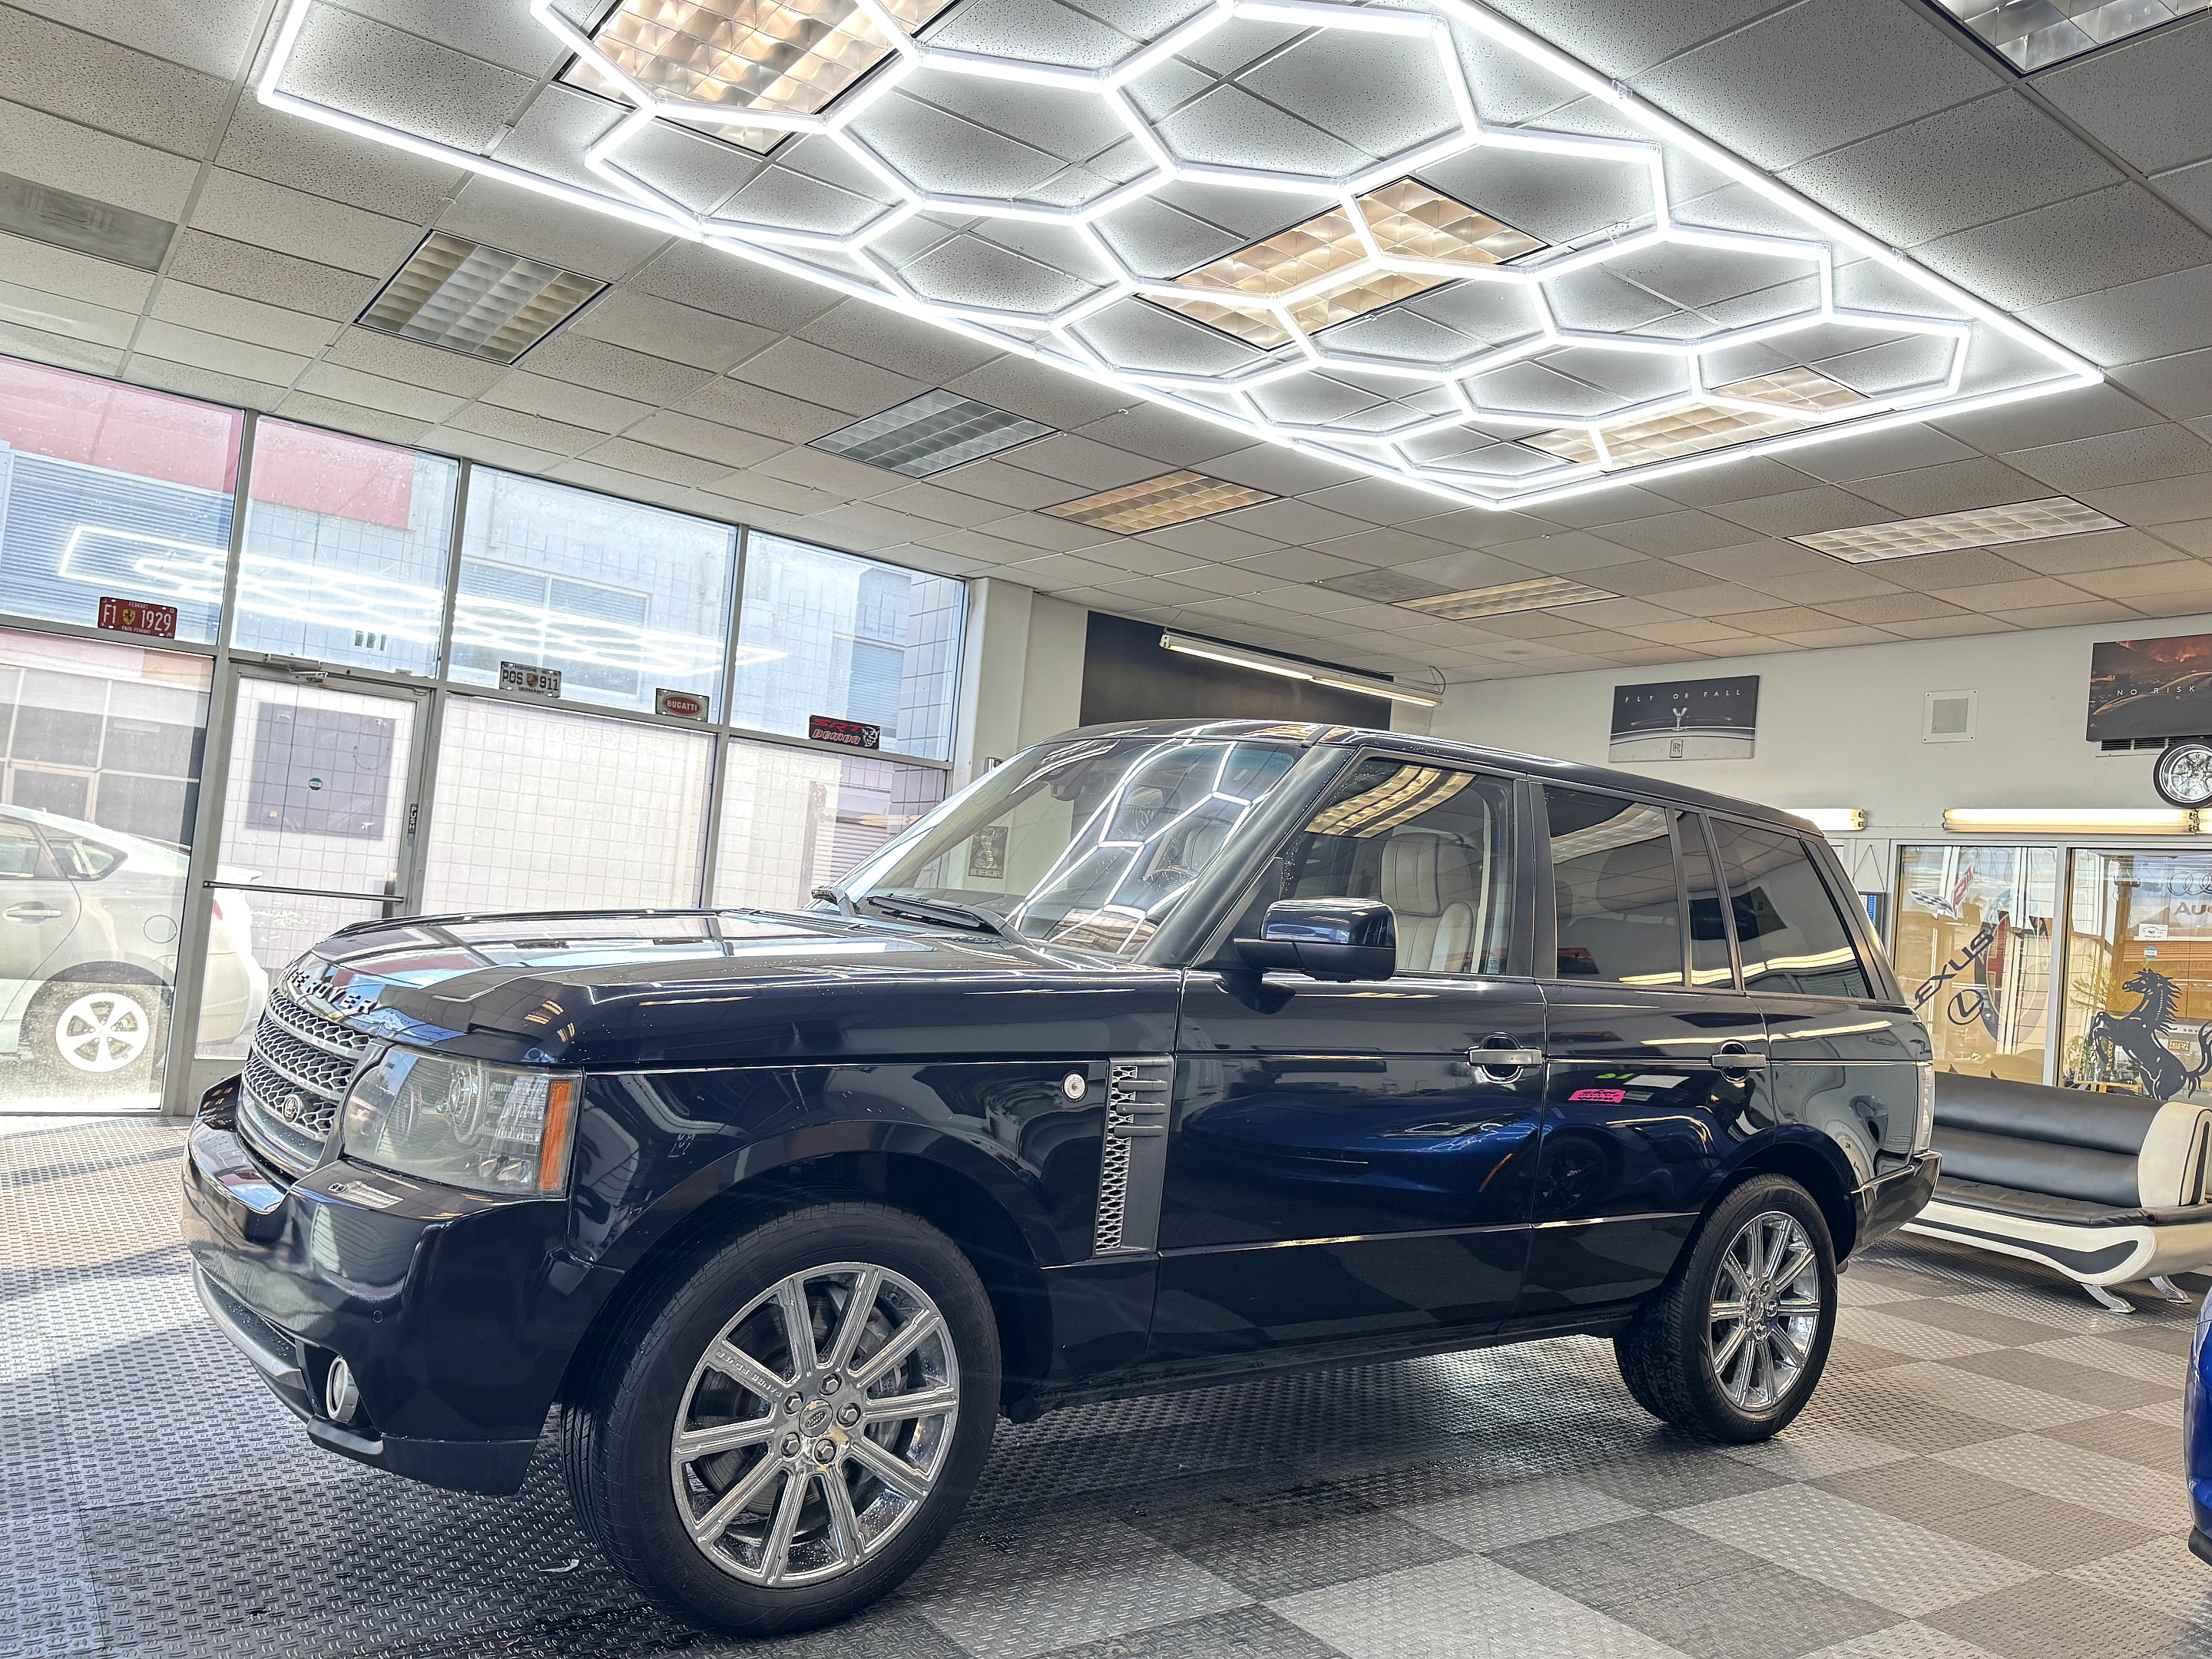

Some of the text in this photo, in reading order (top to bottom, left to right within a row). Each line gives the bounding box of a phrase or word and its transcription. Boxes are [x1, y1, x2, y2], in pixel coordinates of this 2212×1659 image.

[103, 604, 171, 631] F1 1929
[518, 686, 545, 695] GERMANY
[539, 676, 559, 690] 911
[2154, 685, 2196, 694] RISK
[667, 700, 697, 711] BUGATTI
[810, 718, 866, 733] SRT
[409, 806, 418, 830] PUSH
[1912, 929, 1995, 1011] EXUS
[306, 979, 379, 1015] ROVER
